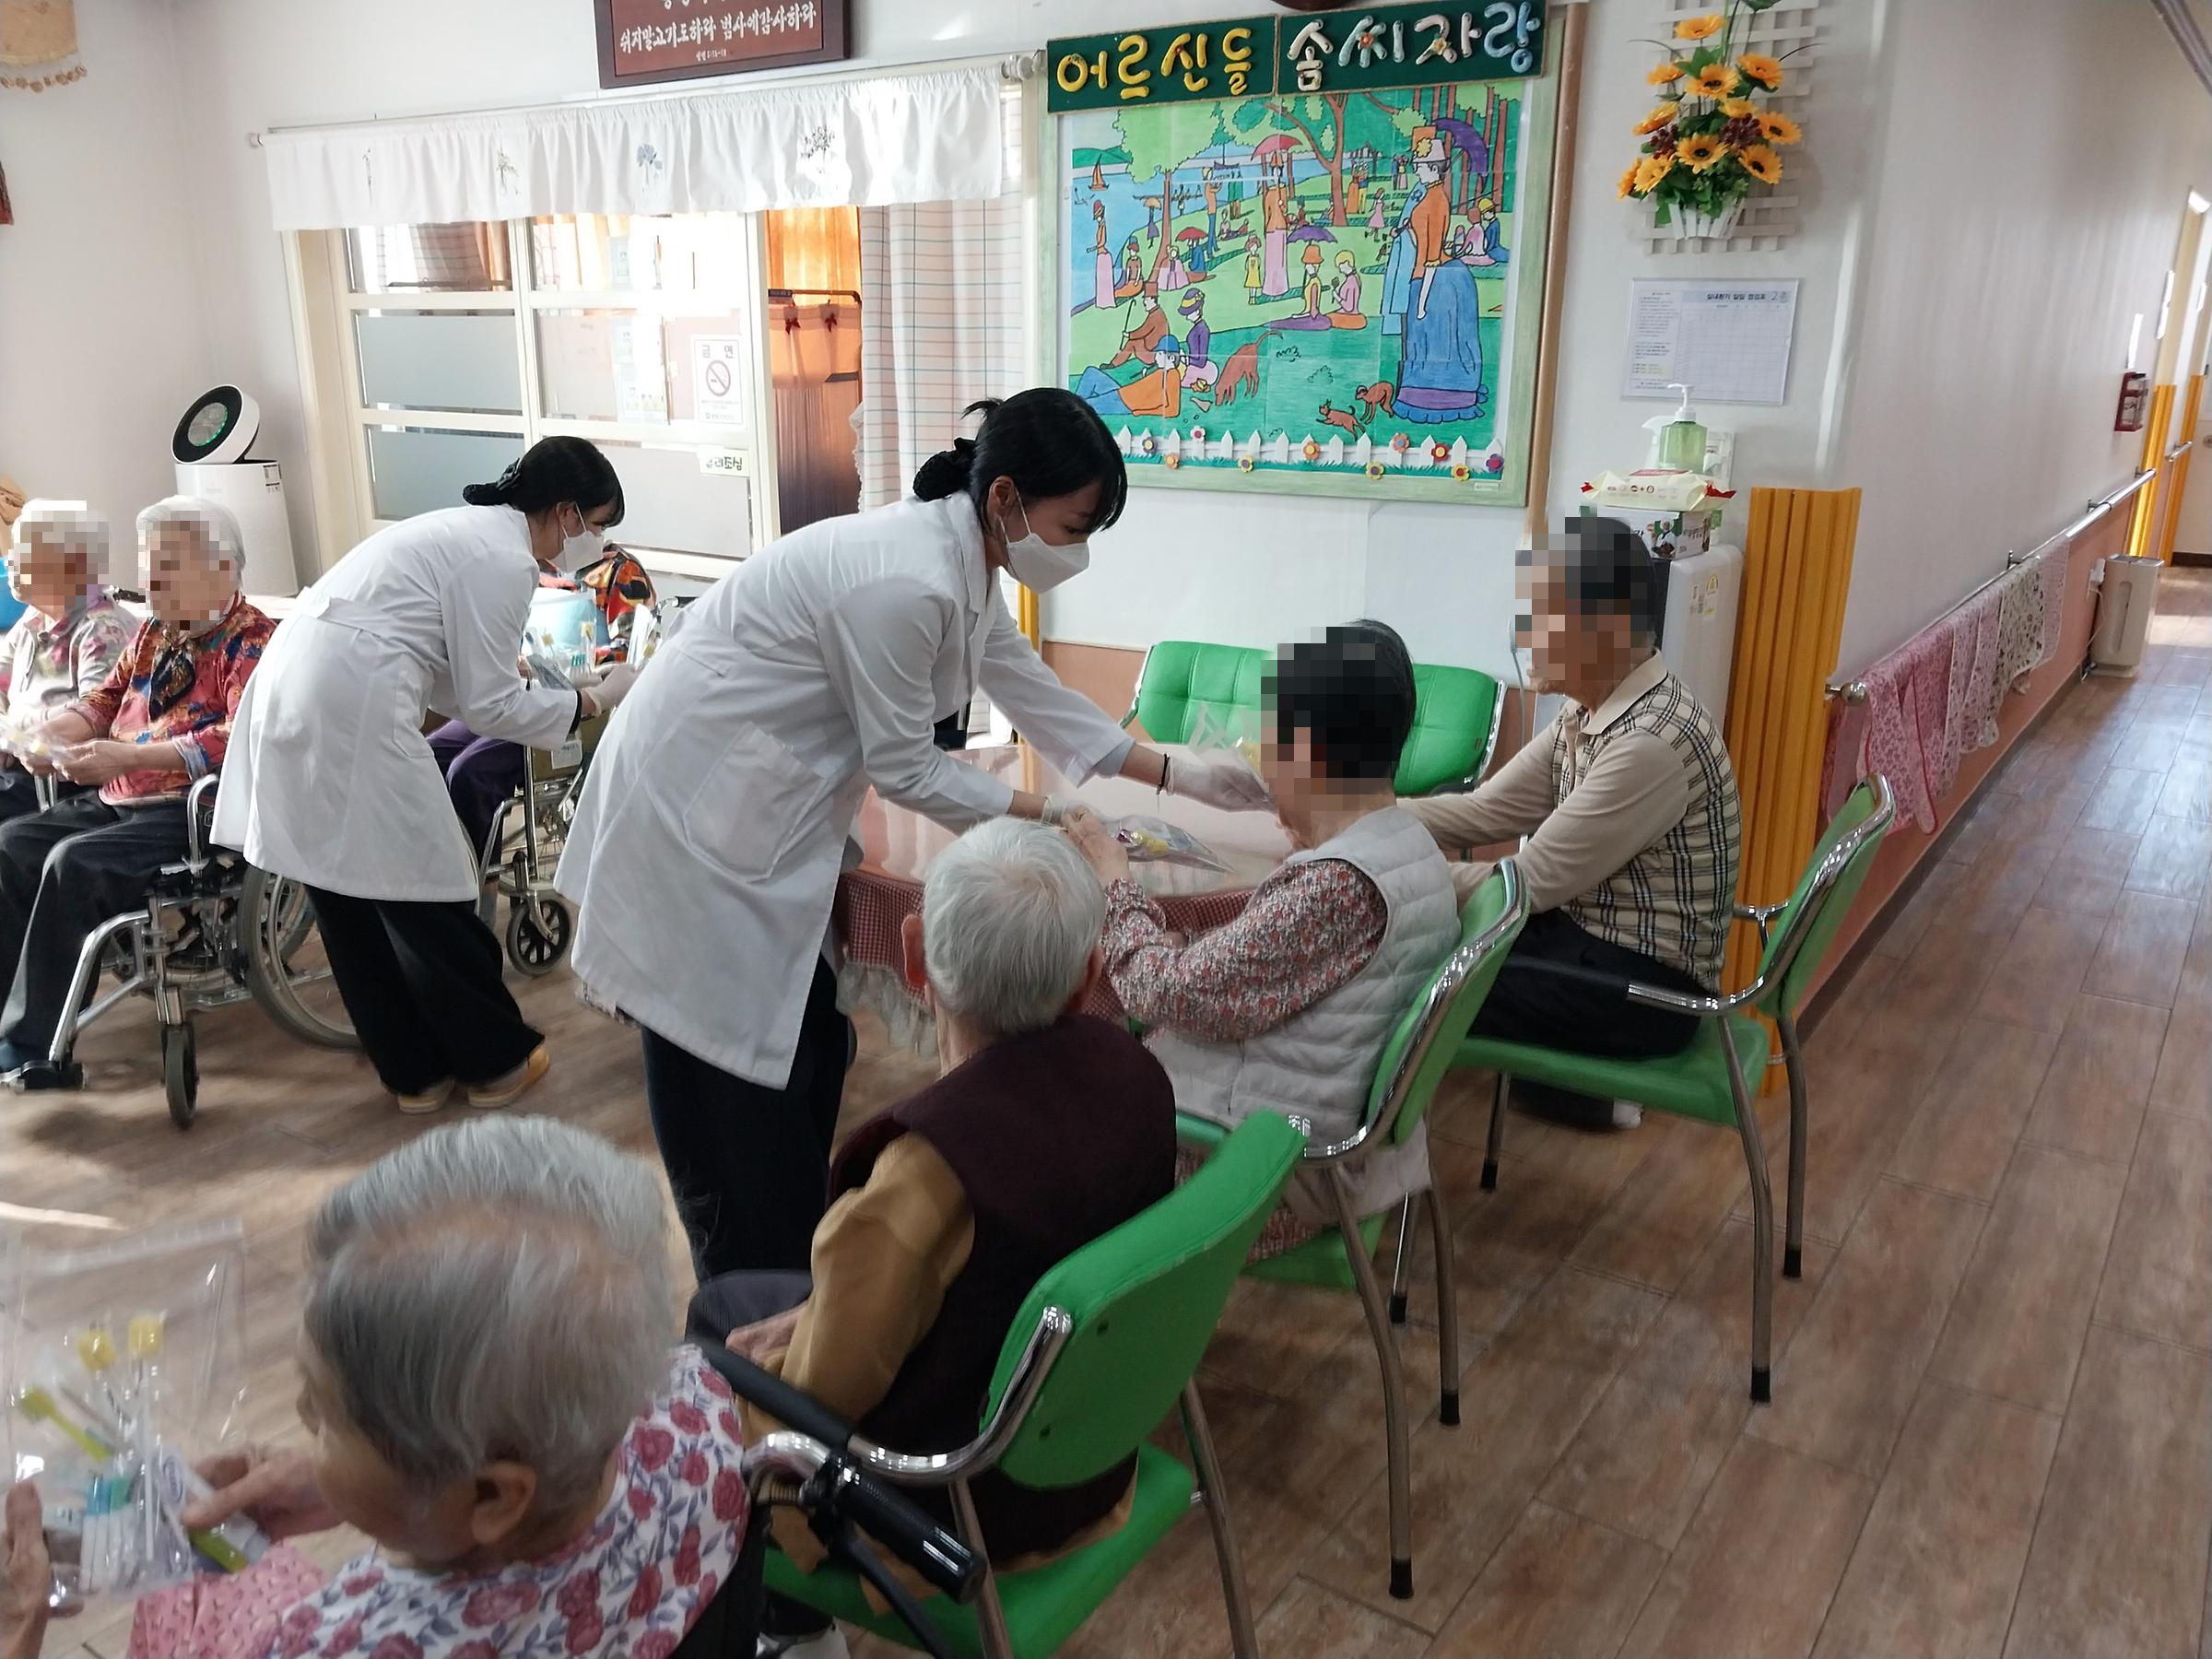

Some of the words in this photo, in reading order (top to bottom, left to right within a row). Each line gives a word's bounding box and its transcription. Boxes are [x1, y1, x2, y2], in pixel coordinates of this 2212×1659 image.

[620, 16, 717, 53] 쉬지말고기도하라
[721, 1, 817, 40] 범사에감사하라
[1056, 28, 1252, 99] 어르신들
